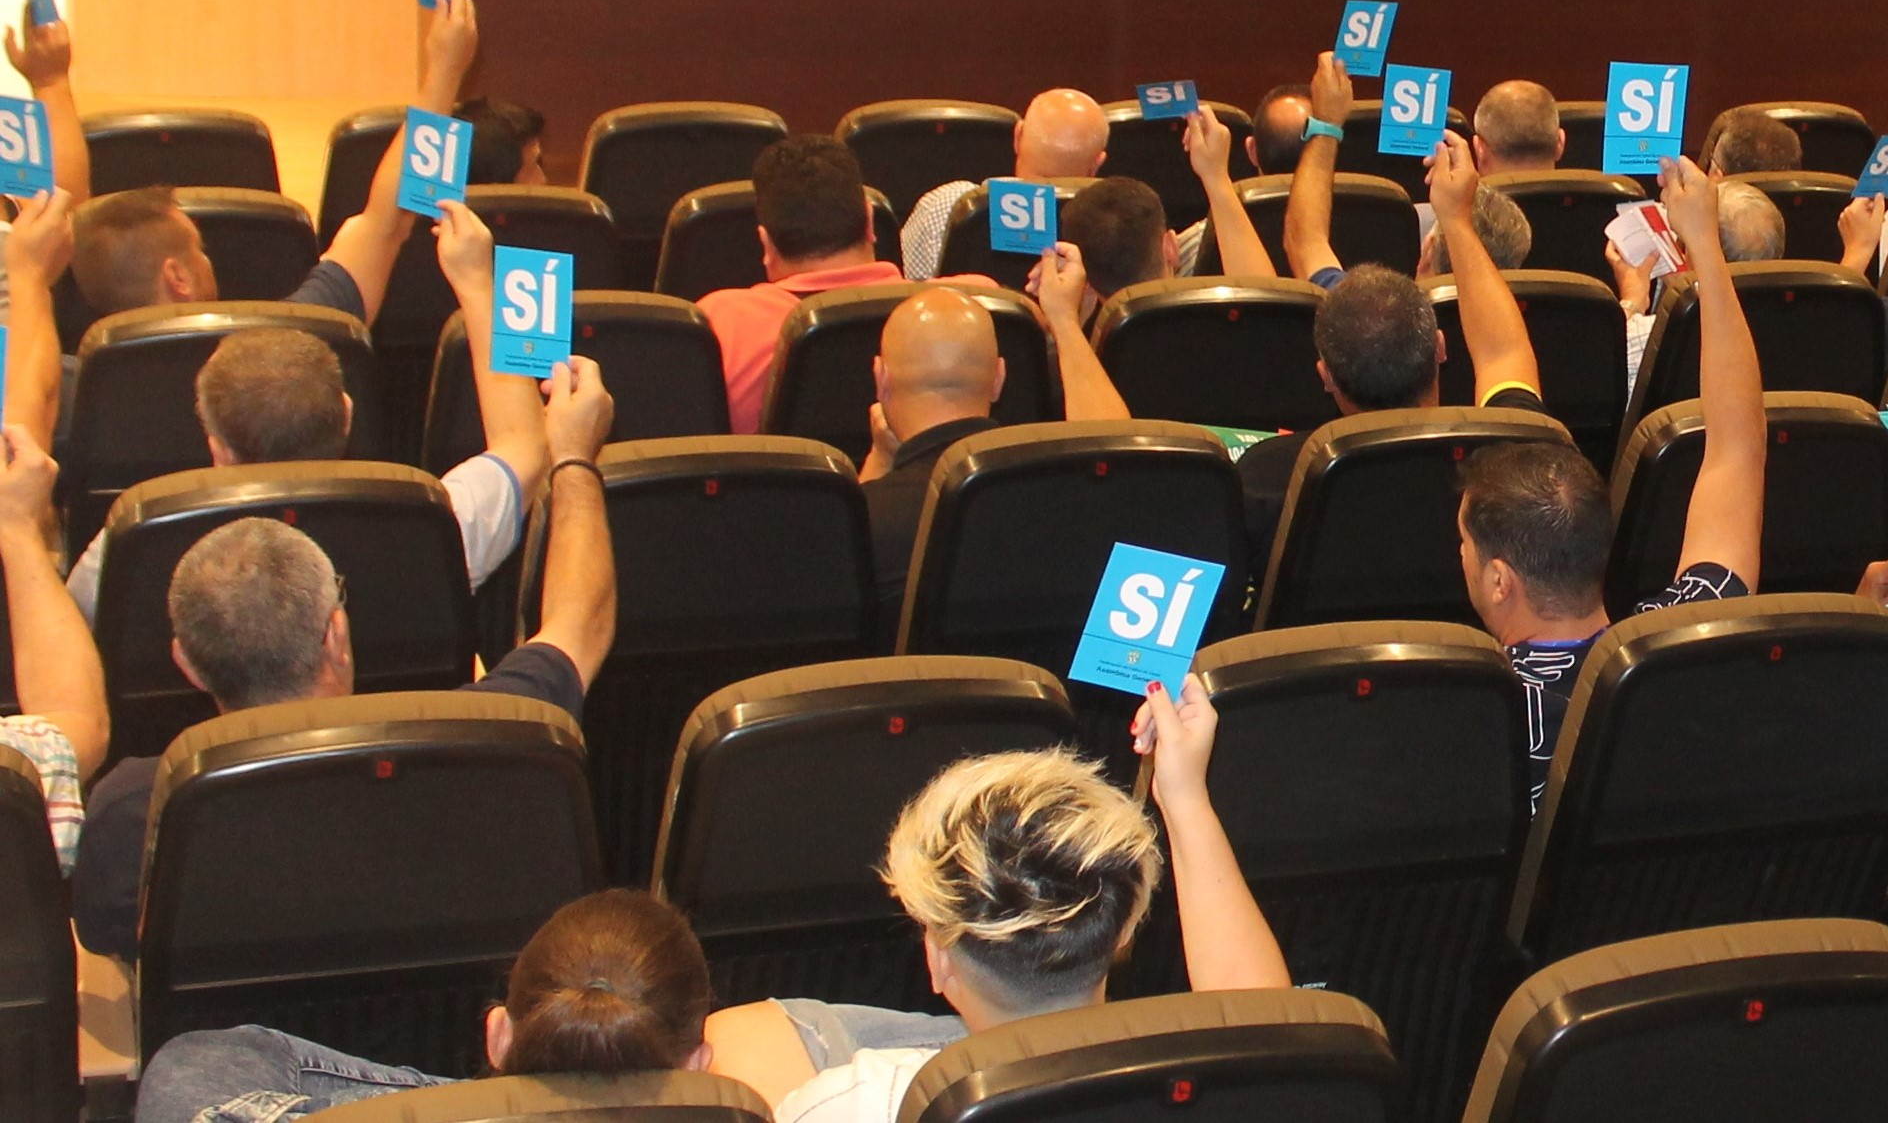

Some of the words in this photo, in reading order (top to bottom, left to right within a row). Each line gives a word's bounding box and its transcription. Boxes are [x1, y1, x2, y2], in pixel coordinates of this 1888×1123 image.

[1342, 4, 1387, 49] SÍ
[1390, 73, 1440, 125] SÍ
[1618, 68, 1678, 133] SÍ
[0, 102, 42, 166] SÍ
[409, 121, 460, 184] SÍ
[1000, 187, 1046, 231] SÍ
[501, 258, 560, 335] SÍ
[1108, 568, 1204, 648] SÍ
